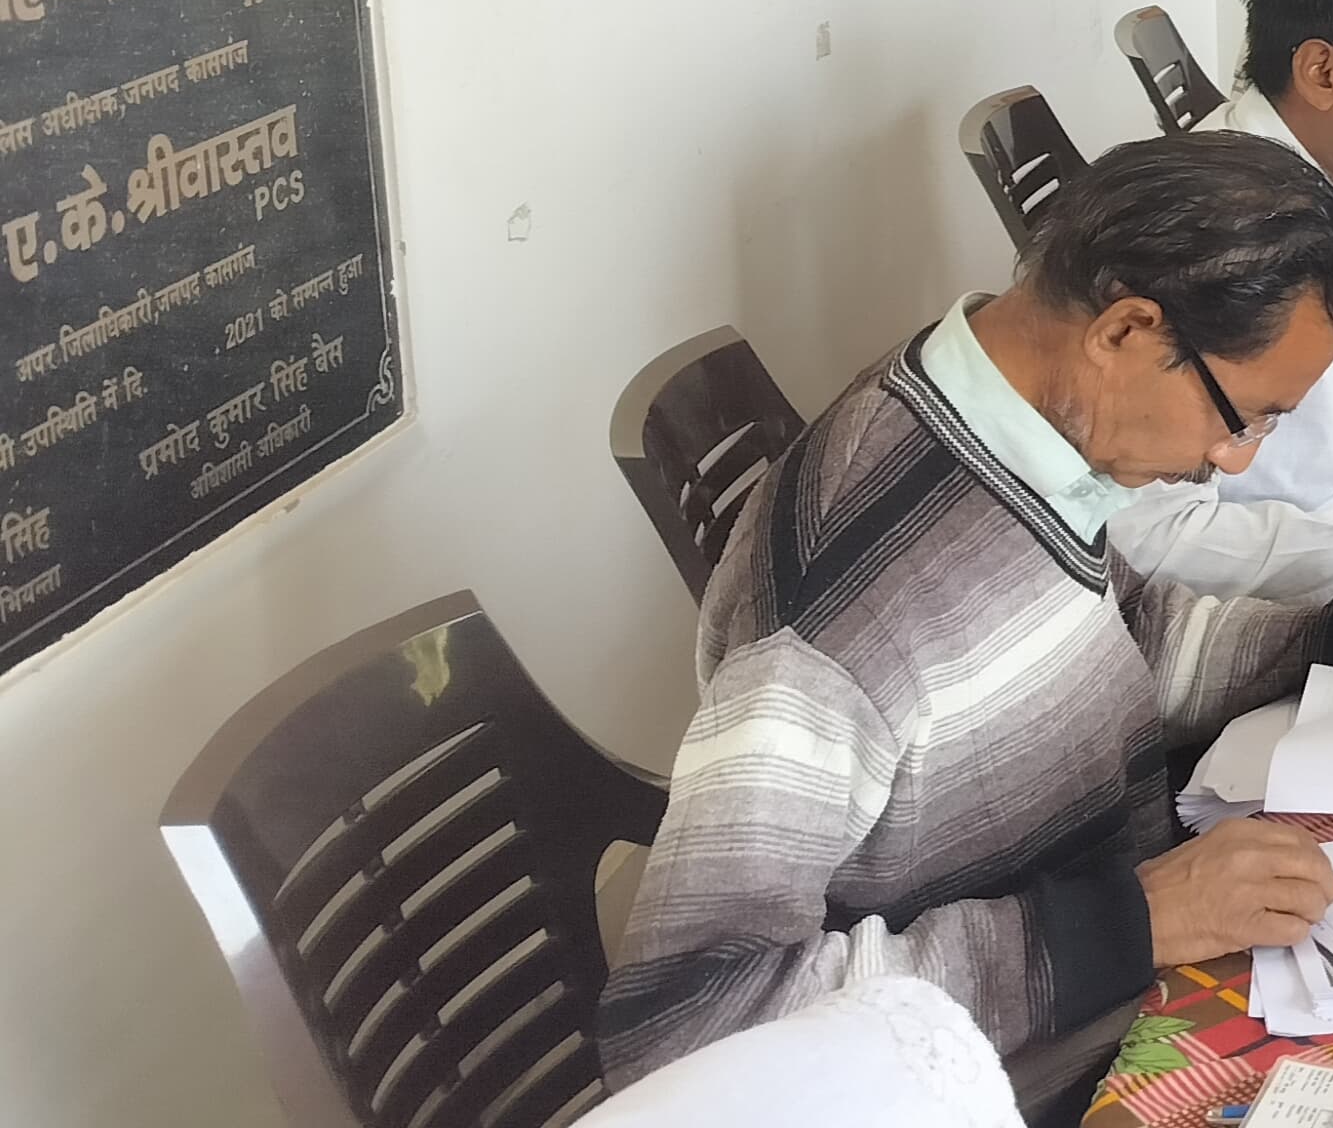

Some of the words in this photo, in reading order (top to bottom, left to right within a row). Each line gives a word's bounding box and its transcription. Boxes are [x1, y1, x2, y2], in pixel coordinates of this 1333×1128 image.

[184, 36, 249, 83] कासगंज
[253, 170, 304, 221] PCS
[16, 342, 57, 382] अपर
[204, 242, 256, 288] कासगंज
[20, 391, 97, 456] उपस्थिति
[102, 377, 118, 410] में
[123, 366, 148, 402] दि.
[225, 309, 264, 350] 2021
[269, 289, 288, 320] को
[337, 253, 363, 295] हुआ
[139, 421, 200, 479] प्रमोद
[207, 382, 266, 448] कुमार
[270, 356, 308, 401] सिंह
[256, 404, 311, 457] अधिकारी
[1, 506, 50, 563] सिंह
